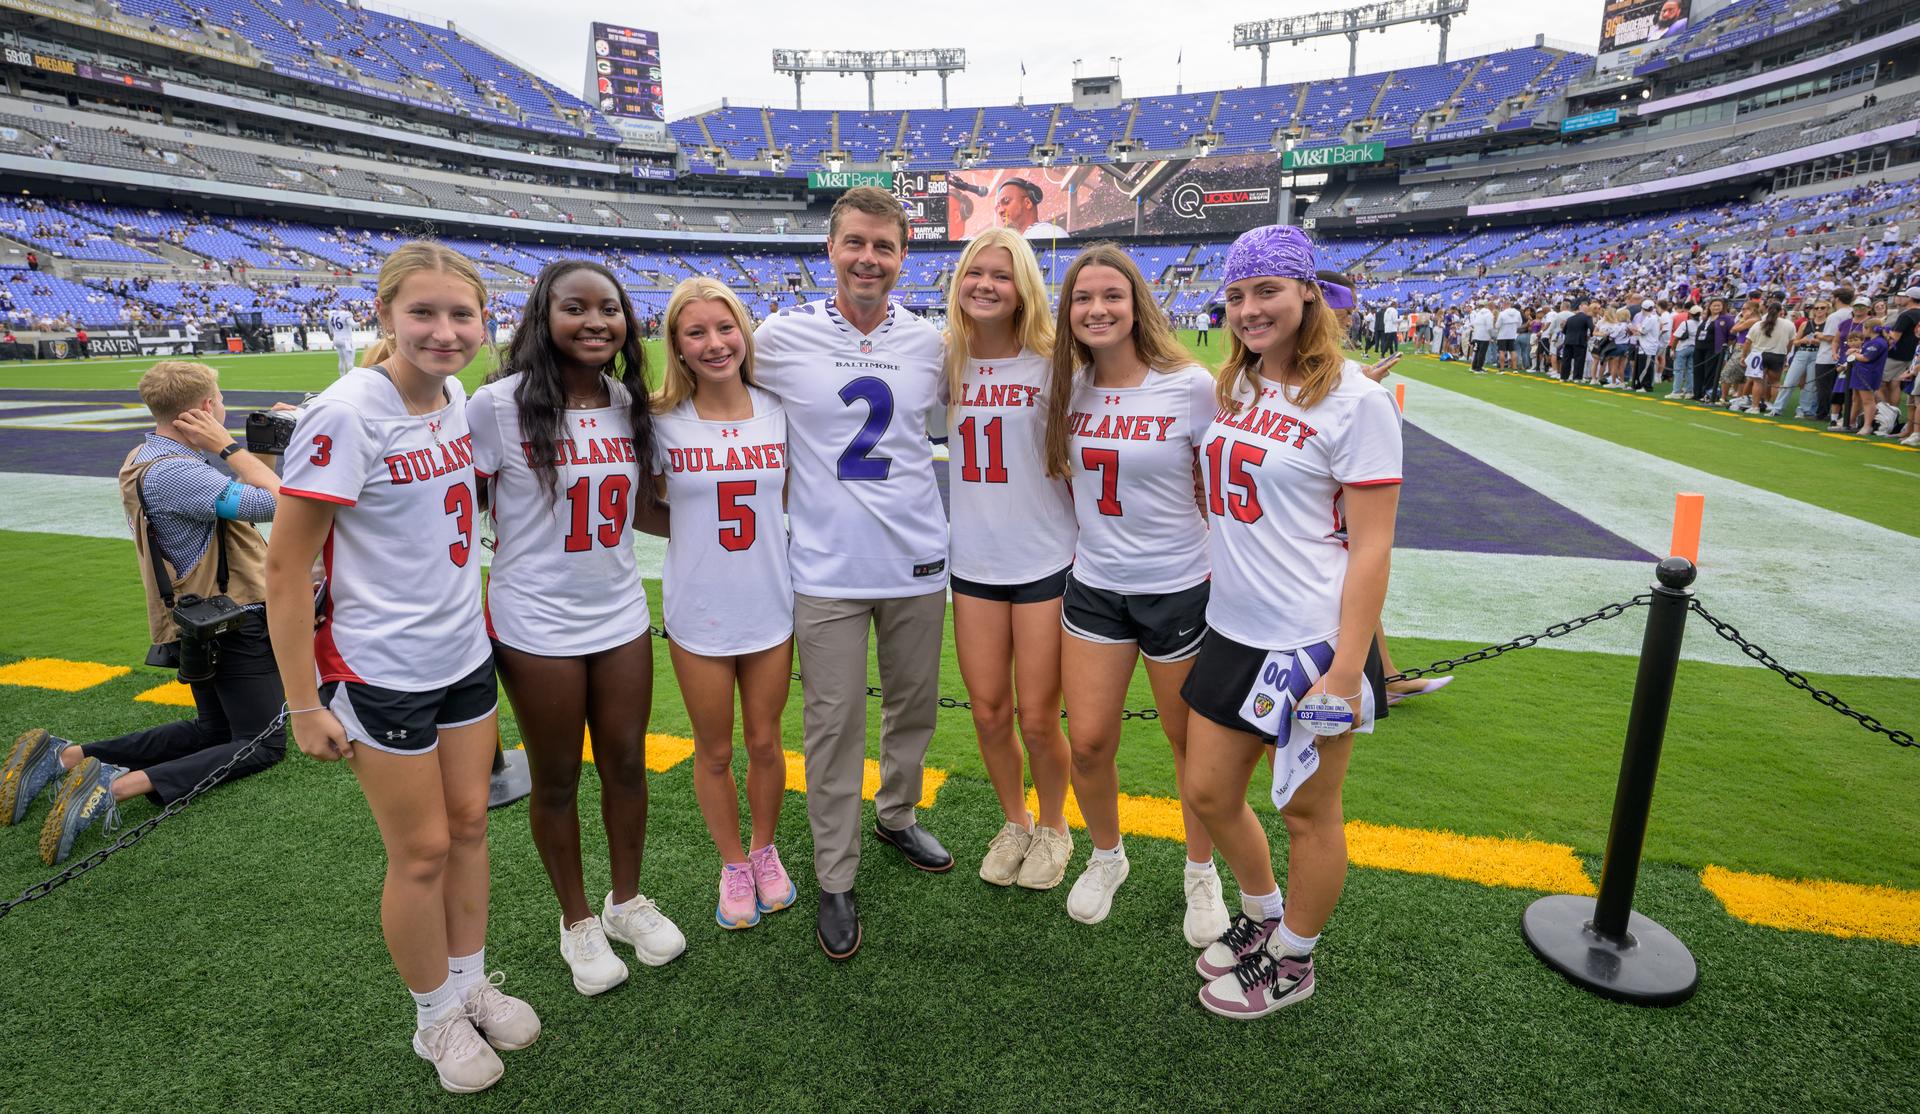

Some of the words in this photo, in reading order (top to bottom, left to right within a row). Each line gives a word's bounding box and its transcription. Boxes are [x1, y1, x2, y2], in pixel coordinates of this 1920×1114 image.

[5, 48, 32, 66] 59:03
[35, 55, 77, 75] PREGAME
[1292, 148, 1333, 167] M&T
[1334, 144, 1373, 164] Bank
[815, 173, 851, 188] M&T
[852, 173, 884, 188] Bank
[928, 182, 947, 193] 59:03
[835, 361, 900, 371] BALTIMORE
[961, 383, 1040, 407] LANEY
[837, 376, 894, 481] 2
[1067, 411, 1176, 441] ULANEY
[310, 434, 333, 467] 3
[384, 433, 474, 485] DULAN
[958, 416, 1008, 484] 11
[1081, 447, 1123, 517] 7
[1205, 435, 1268, 524] 15
[444, 482, 473, 568] 3
[564, 474, 631, 553] 19
[717, 480, 757, 552] 5
[1263, 661, 1291, 692] 00
[1300, 711, 1314, 719] 037
[80, 784, 107, 818] HOKA
